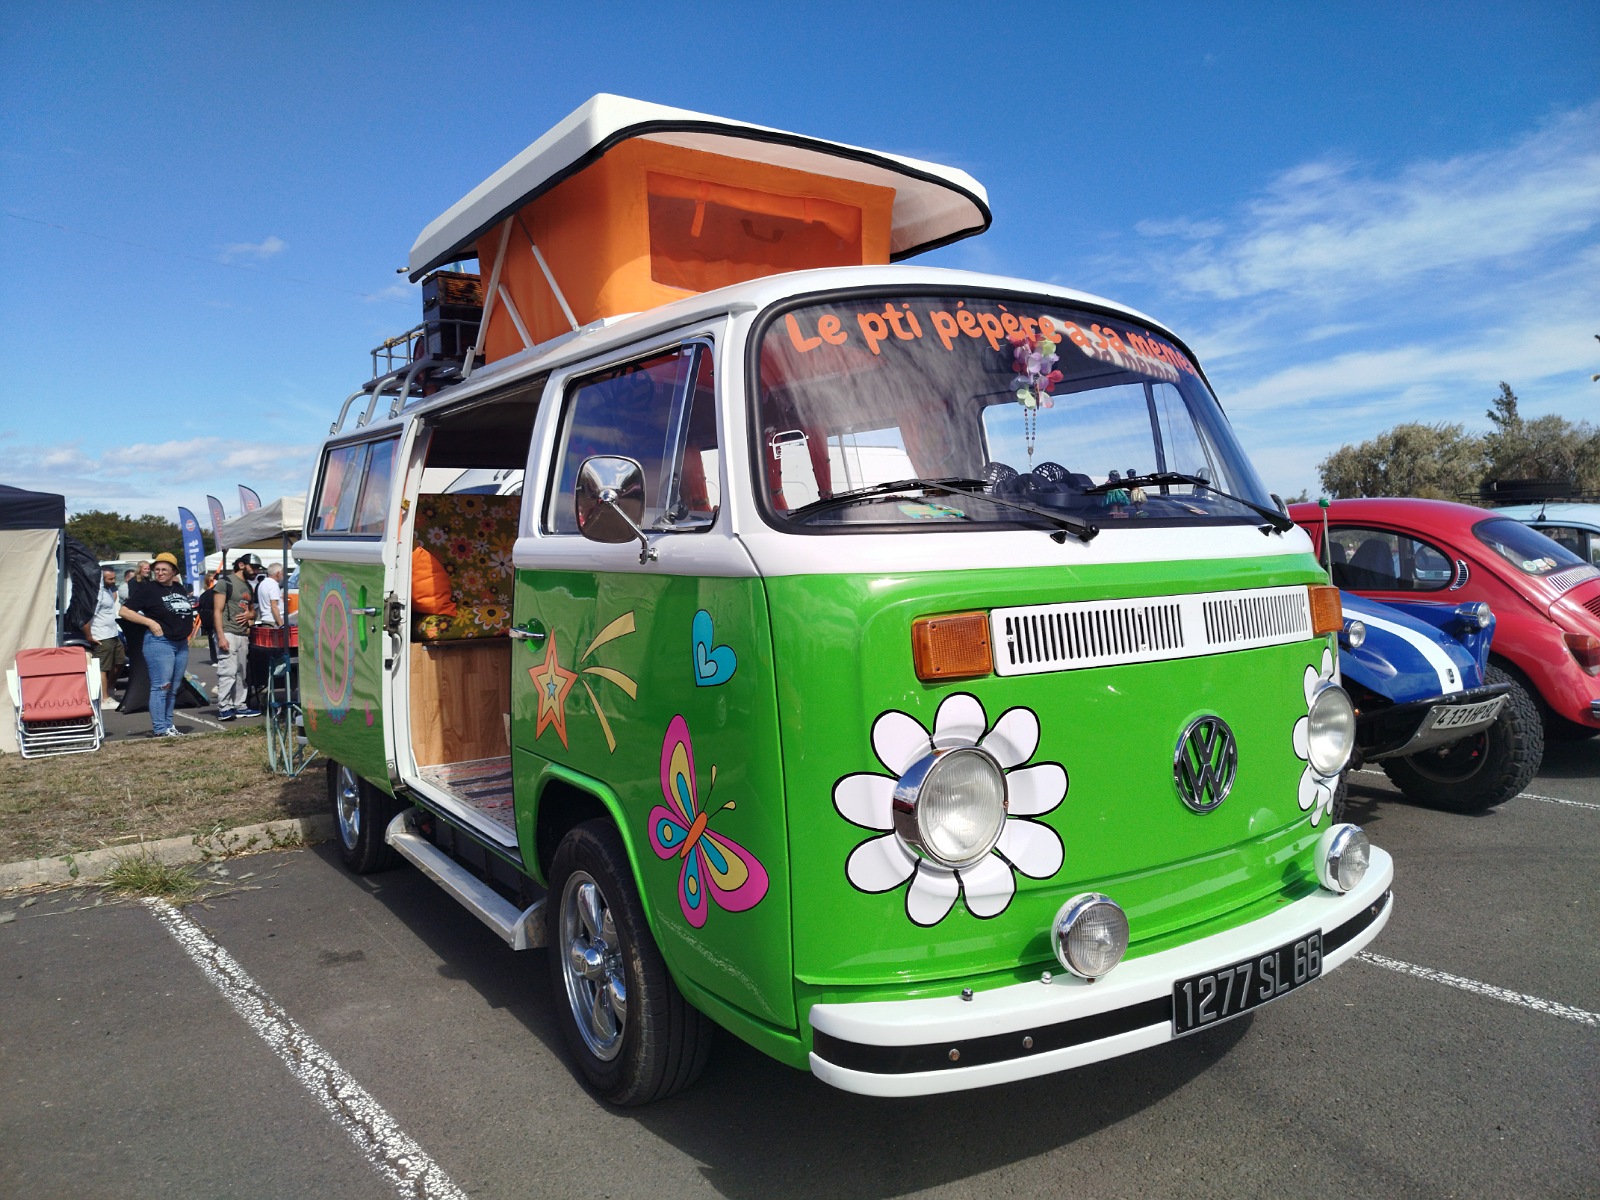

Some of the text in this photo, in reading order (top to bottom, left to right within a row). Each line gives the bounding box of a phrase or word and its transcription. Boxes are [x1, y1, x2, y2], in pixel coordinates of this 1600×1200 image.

[785, 313, 848, 353] Le
[857, 303, 923, 355] pti
[930, 301, 1062, 352] pépère
[1091, 323, 1128, 355] sa
[1183, 935, 1320, 1028] 1277 SL 66
